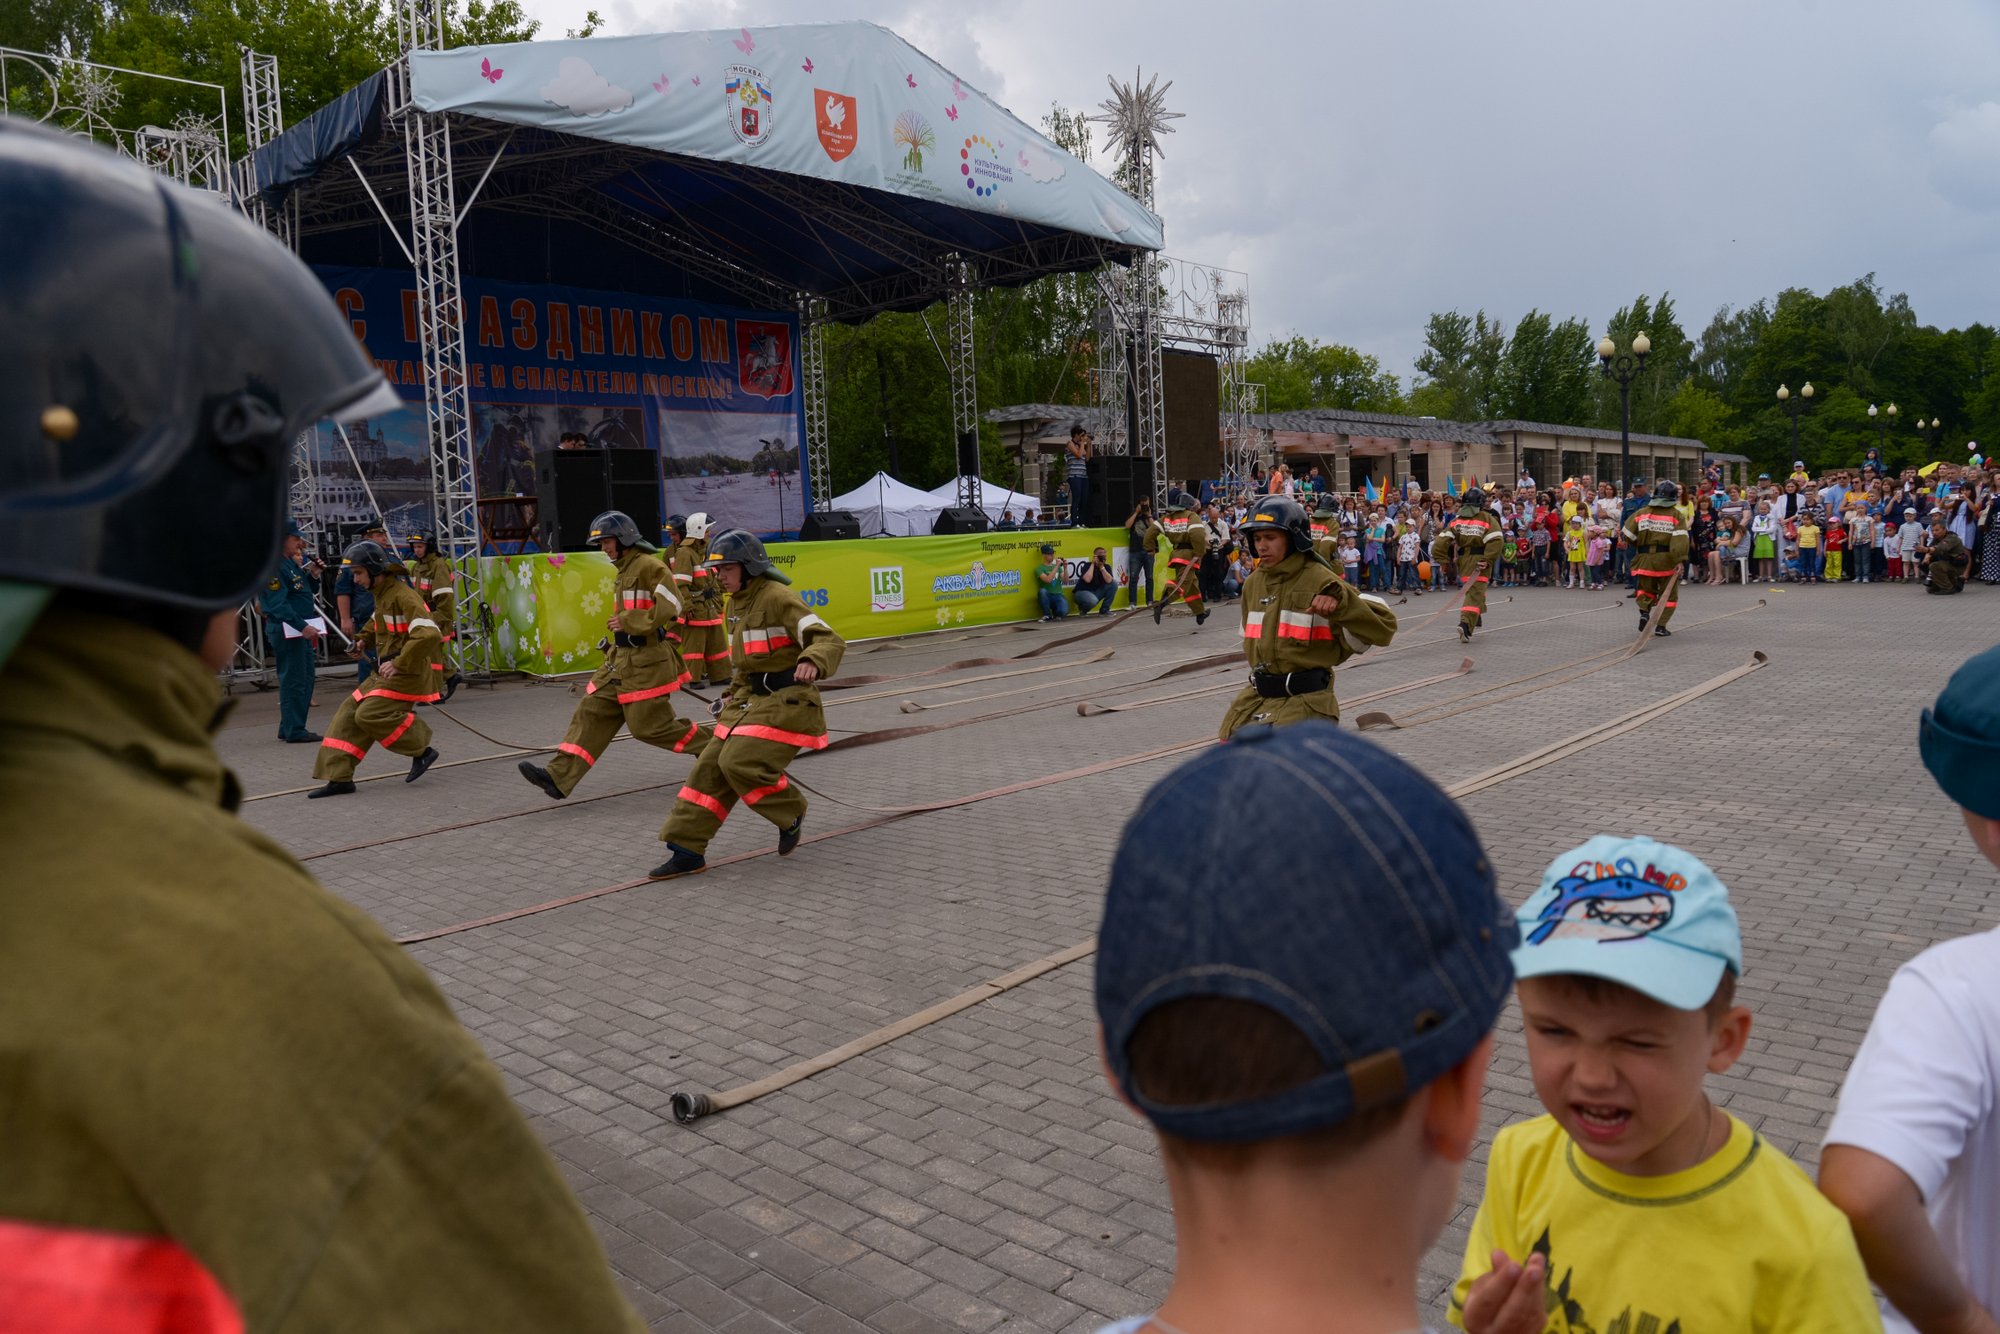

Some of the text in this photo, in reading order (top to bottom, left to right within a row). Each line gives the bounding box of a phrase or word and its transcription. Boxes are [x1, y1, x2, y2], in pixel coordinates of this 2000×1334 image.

[732, 65, 762, 79] МОСКВА
[974, 158, 1012, 175] КУЛЬТУРНЫЕ
[974, 166, 1013, 183] ИННОВАЦИИ
[335, 287, 730, 364] С ПРАЗДНИКОМ
[491, 364, 506, 388] И
[512, 365, 637, 394] СПАСАТЕЛИ
[980, 541, 1016, 555] Партнеры
[873, 570, 901, 595] LES
[874, 594, 902, 603] FITNESS
